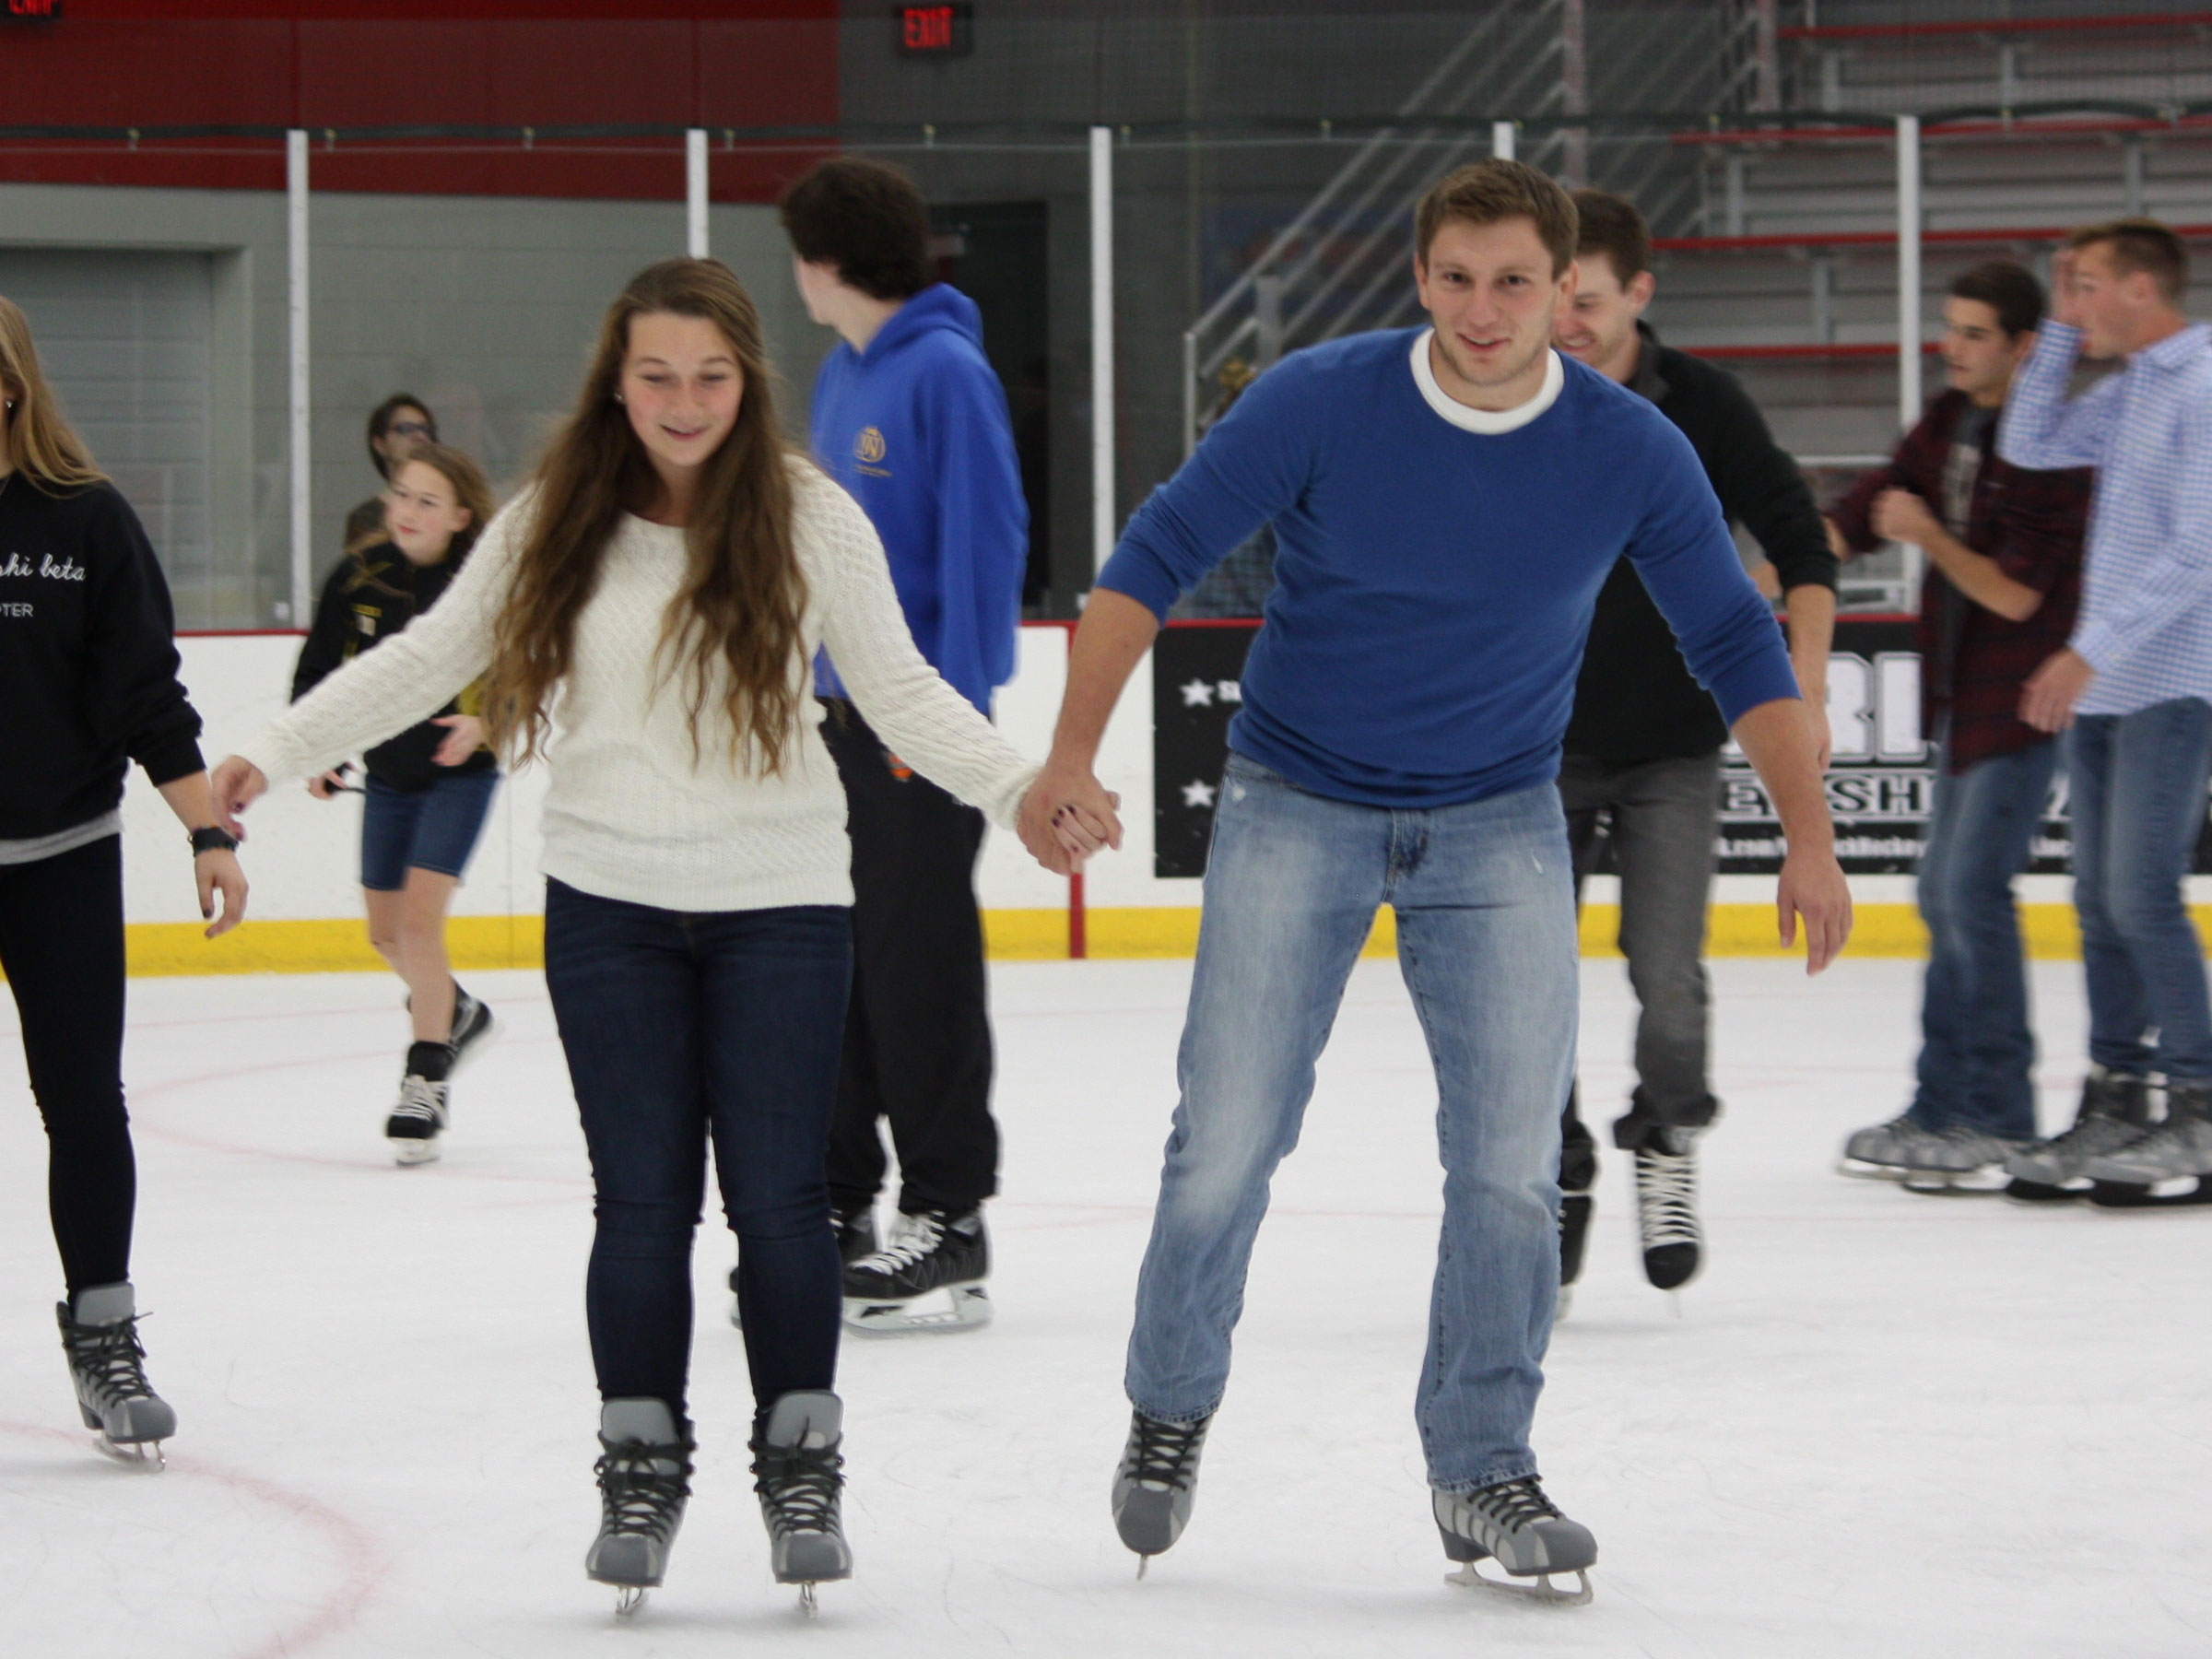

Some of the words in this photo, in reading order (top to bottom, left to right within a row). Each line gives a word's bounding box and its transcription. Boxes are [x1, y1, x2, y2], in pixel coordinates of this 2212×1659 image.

[904, 6, 953, 49] EXIT
[0, 552, 33, 577] hi
[40, 553, 87, 582] beta
[0, 603, 34, 618] TER
